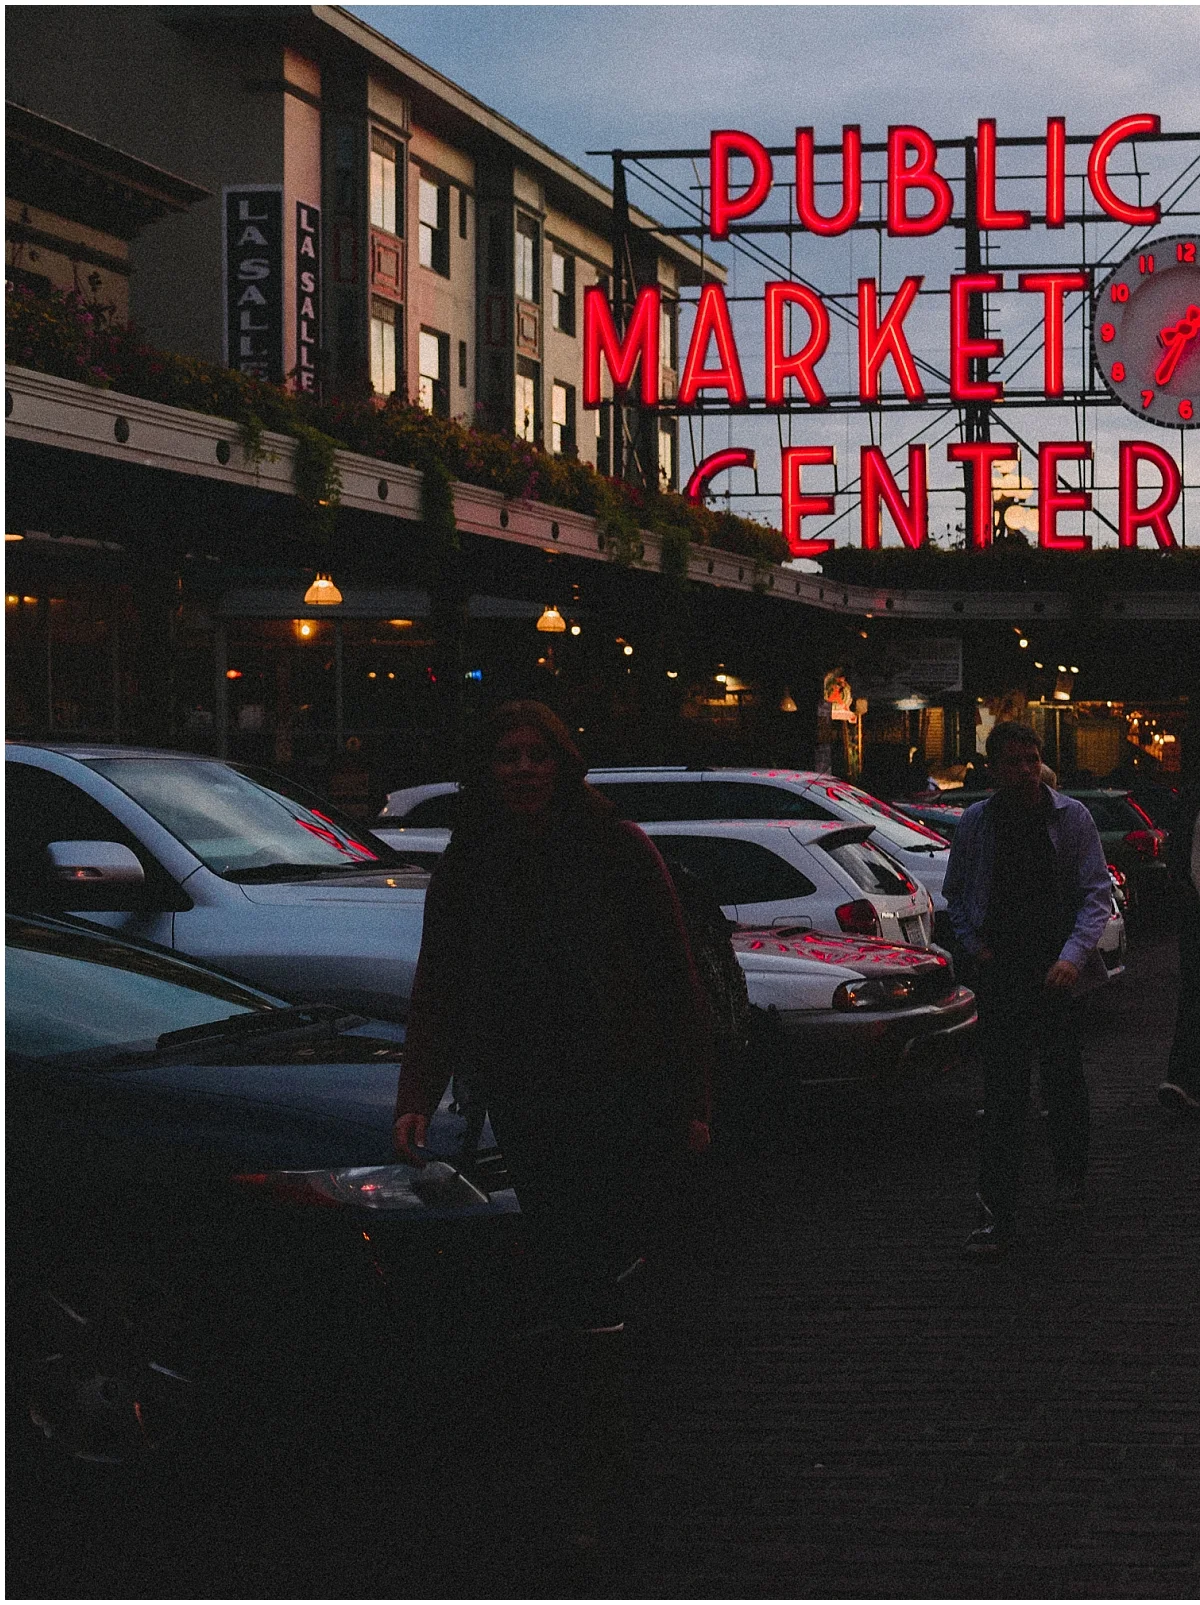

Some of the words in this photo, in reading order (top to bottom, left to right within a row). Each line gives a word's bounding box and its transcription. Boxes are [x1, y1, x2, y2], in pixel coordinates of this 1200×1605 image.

[710, 114, 1161, 241] PUBLIC
[238, 200, 268, 246] LA
[300, 208, 315, 259] LA
[1177, 243, 1196, 262] 12
[1139, 254, 1155, 275] 11
[1111, 283, 1129, 303] 10
[300, 271, 315, 393] SALLE
[583, 274, 1090, 409] MARKET
[1100, 323, 1115, 342] 9
[1112, 362, 1125, 382] 8
[1141, 390, 1154, 409] 7
[1178, 400, 1193, 420] 6
